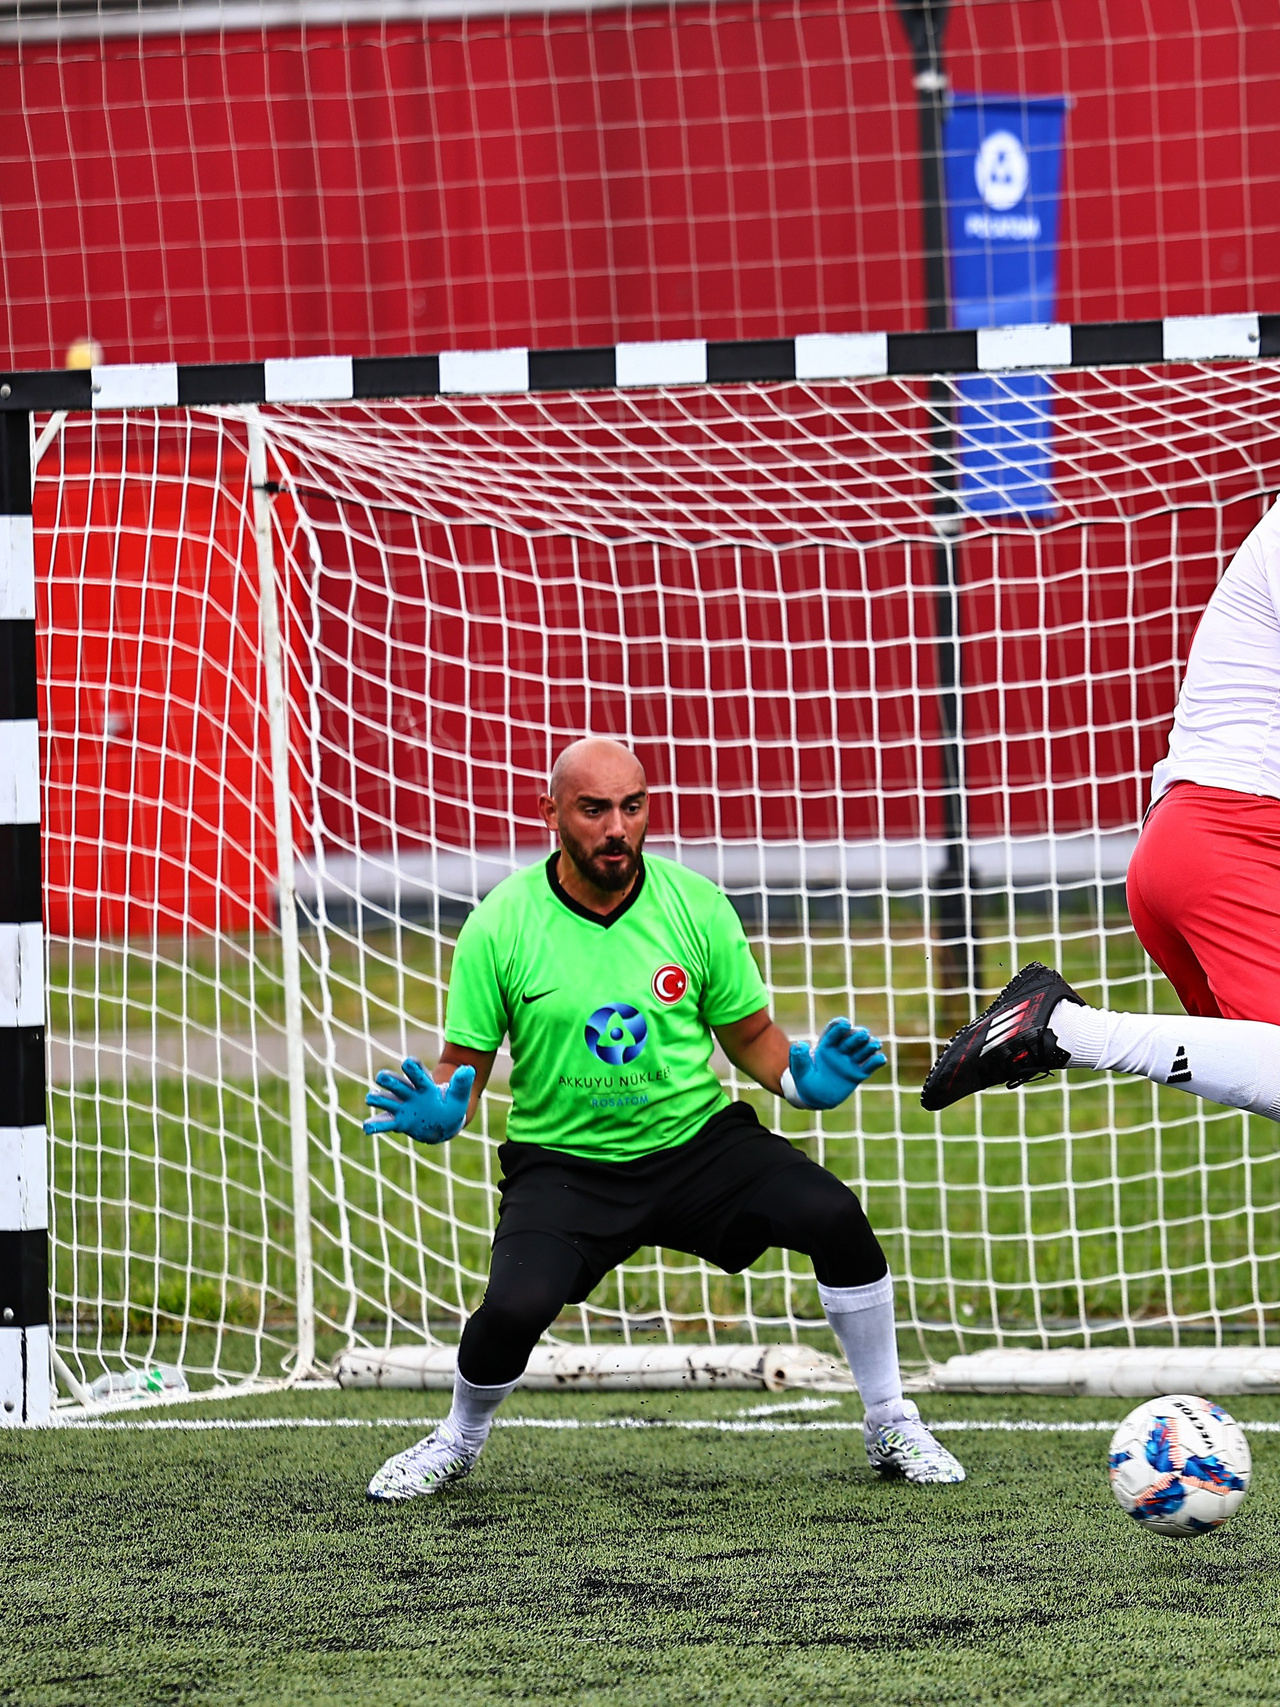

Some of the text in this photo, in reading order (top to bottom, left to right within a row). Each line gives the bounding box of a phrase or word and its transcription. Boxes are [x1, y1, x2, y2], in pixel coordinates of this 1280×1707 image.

[558, 1075, 613, 1088] AKKUYU
[592, 1095, 649, 1108] ROSATOM
[1172, 1402, 1215, 1450] VECTOR
